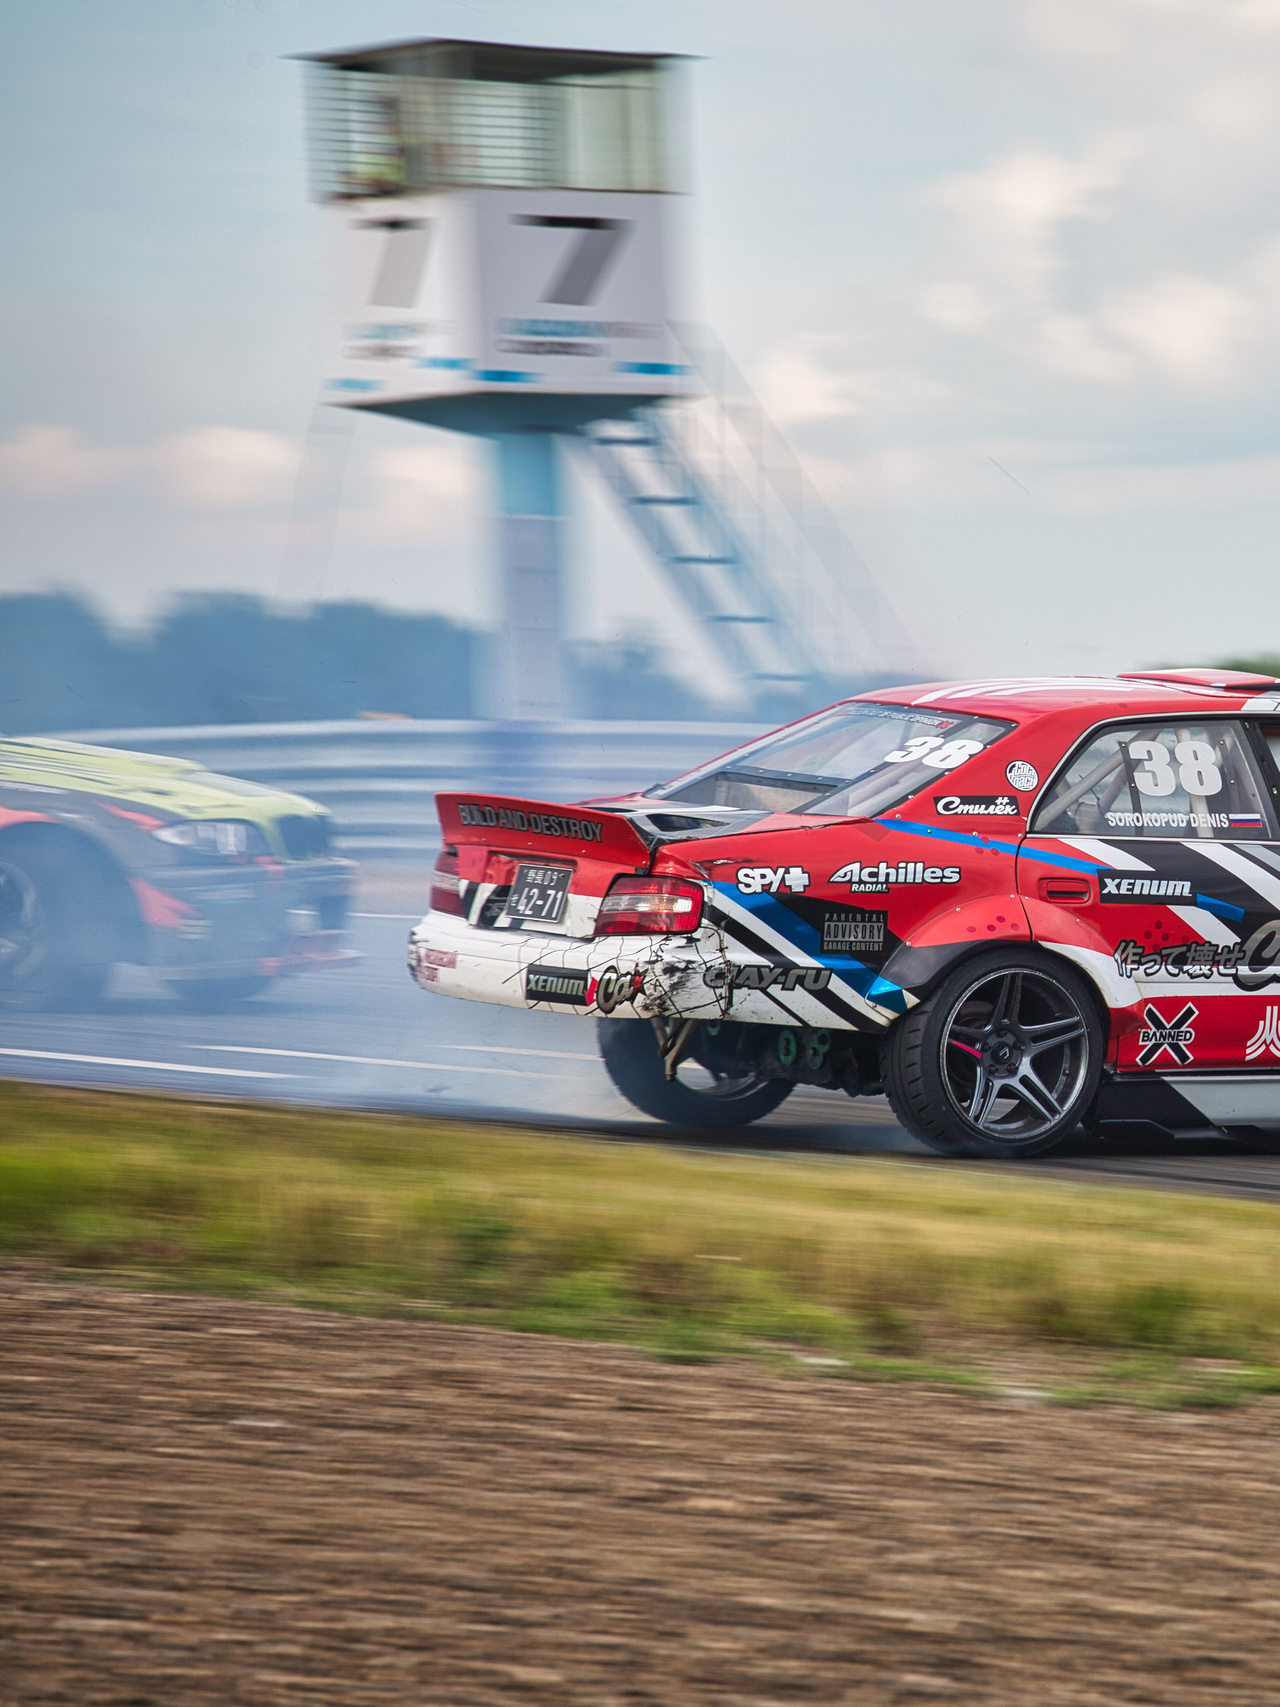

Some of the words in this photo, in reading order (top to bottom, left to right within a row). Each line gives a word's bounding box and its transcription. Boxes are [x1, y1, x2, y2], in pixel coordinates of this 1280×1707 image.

[509, 213, 636, 307] 7
[884, 736, 984, 769] 38
[1128, 740, 1223, 797] 38
[936, 796, 1018, 815] Стилёк
[458, 804, 496, 826] BUILD
[498, 807, 529, 832] AND
[529, 813, 603, 842] DESTROY
[1107, 812, 1189, 827] SOROKOPUD
[1190, 813, 1230, 828] DENIS
[828, 862, 961, 884] Achilles
[851, 883, 888, 893] RADIAL
[516, 887, 564, 918] 42-71
[825, 913, 884, 922] PARENTAL
[825, 923, 883, 940] ADVISORY
[823, 941, 850, 951] GARAGE
[851, 942, 884, 952] CONTENT
[1113, 941, 1246, 979] 作って壊せ
[1141, 1030, 1193, 1043] BANNED
